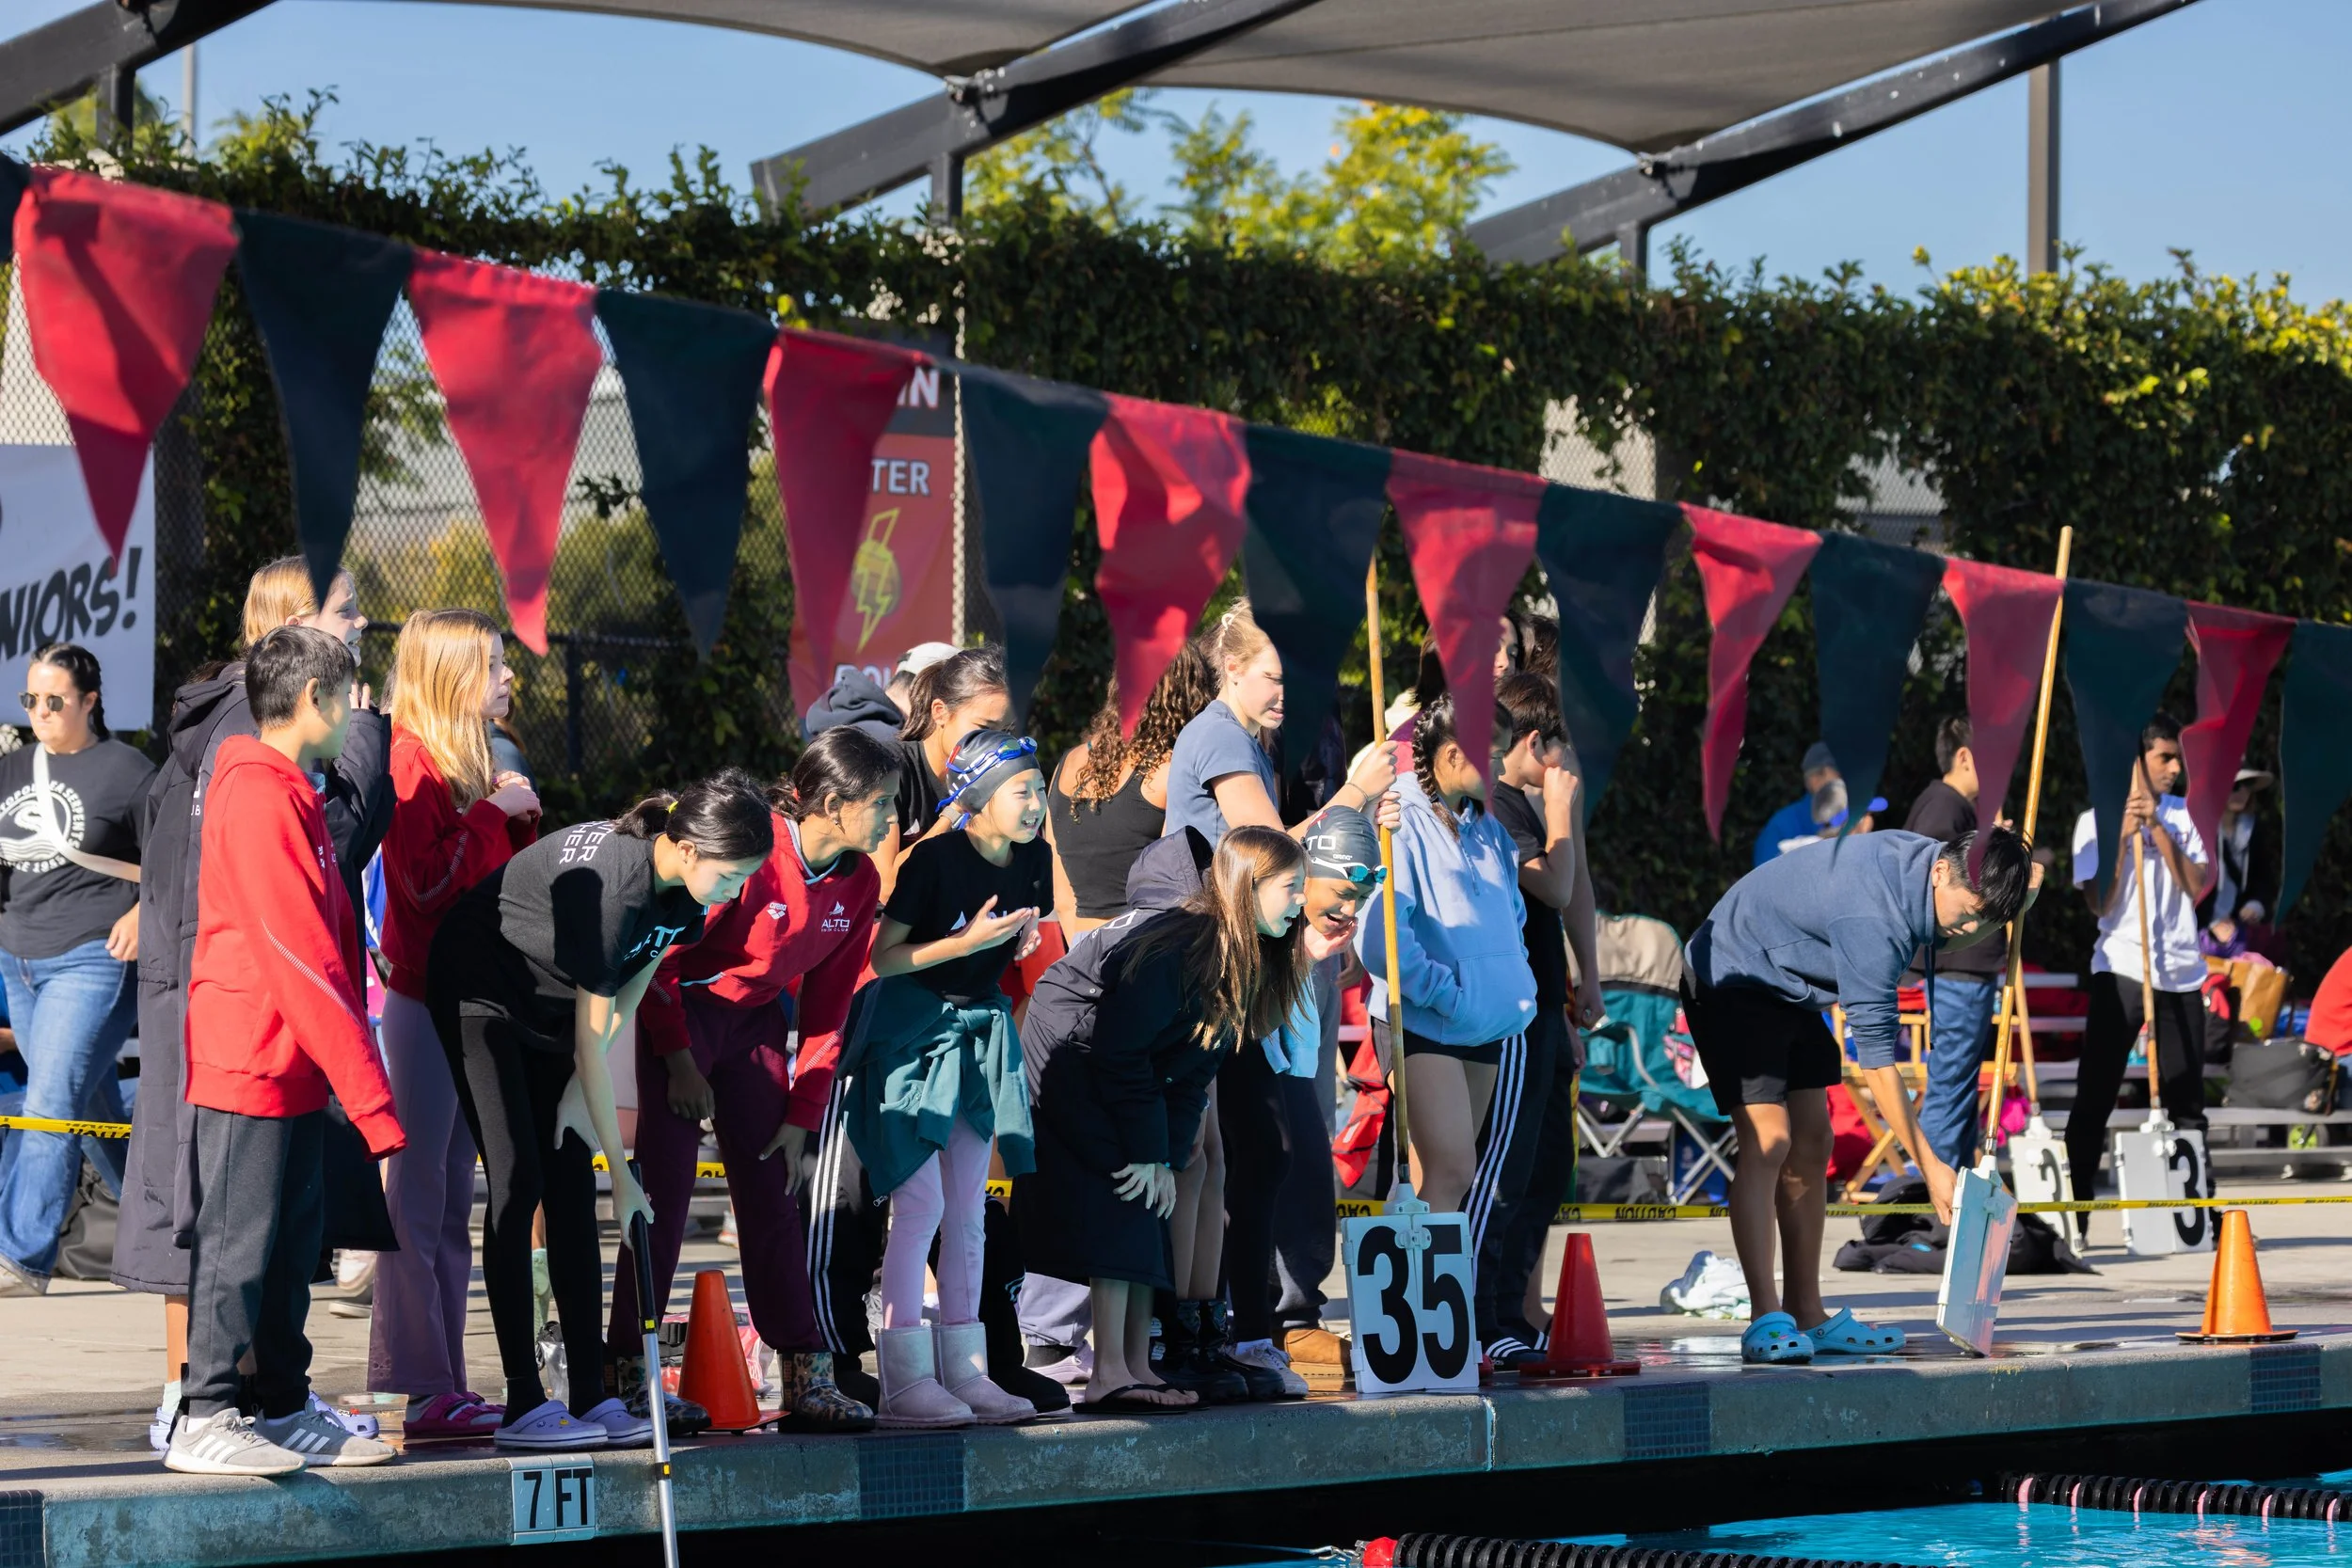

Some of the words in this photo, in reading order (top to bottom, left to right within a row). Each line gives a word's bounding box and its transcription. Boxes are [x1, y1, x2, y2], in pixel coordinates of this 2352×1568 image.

[769, 902, 787, 911] arena
[821, 919, 850, 928] ALTO
[2169, 1138, 2205, 1246] 3
[1615, 1206, 1677, 1220] CAUTION
[1357, 1224, 1470, 1385] 35
[523, 1470, 543, 1529] 7
[554, 1467, 593, 1528] FT
